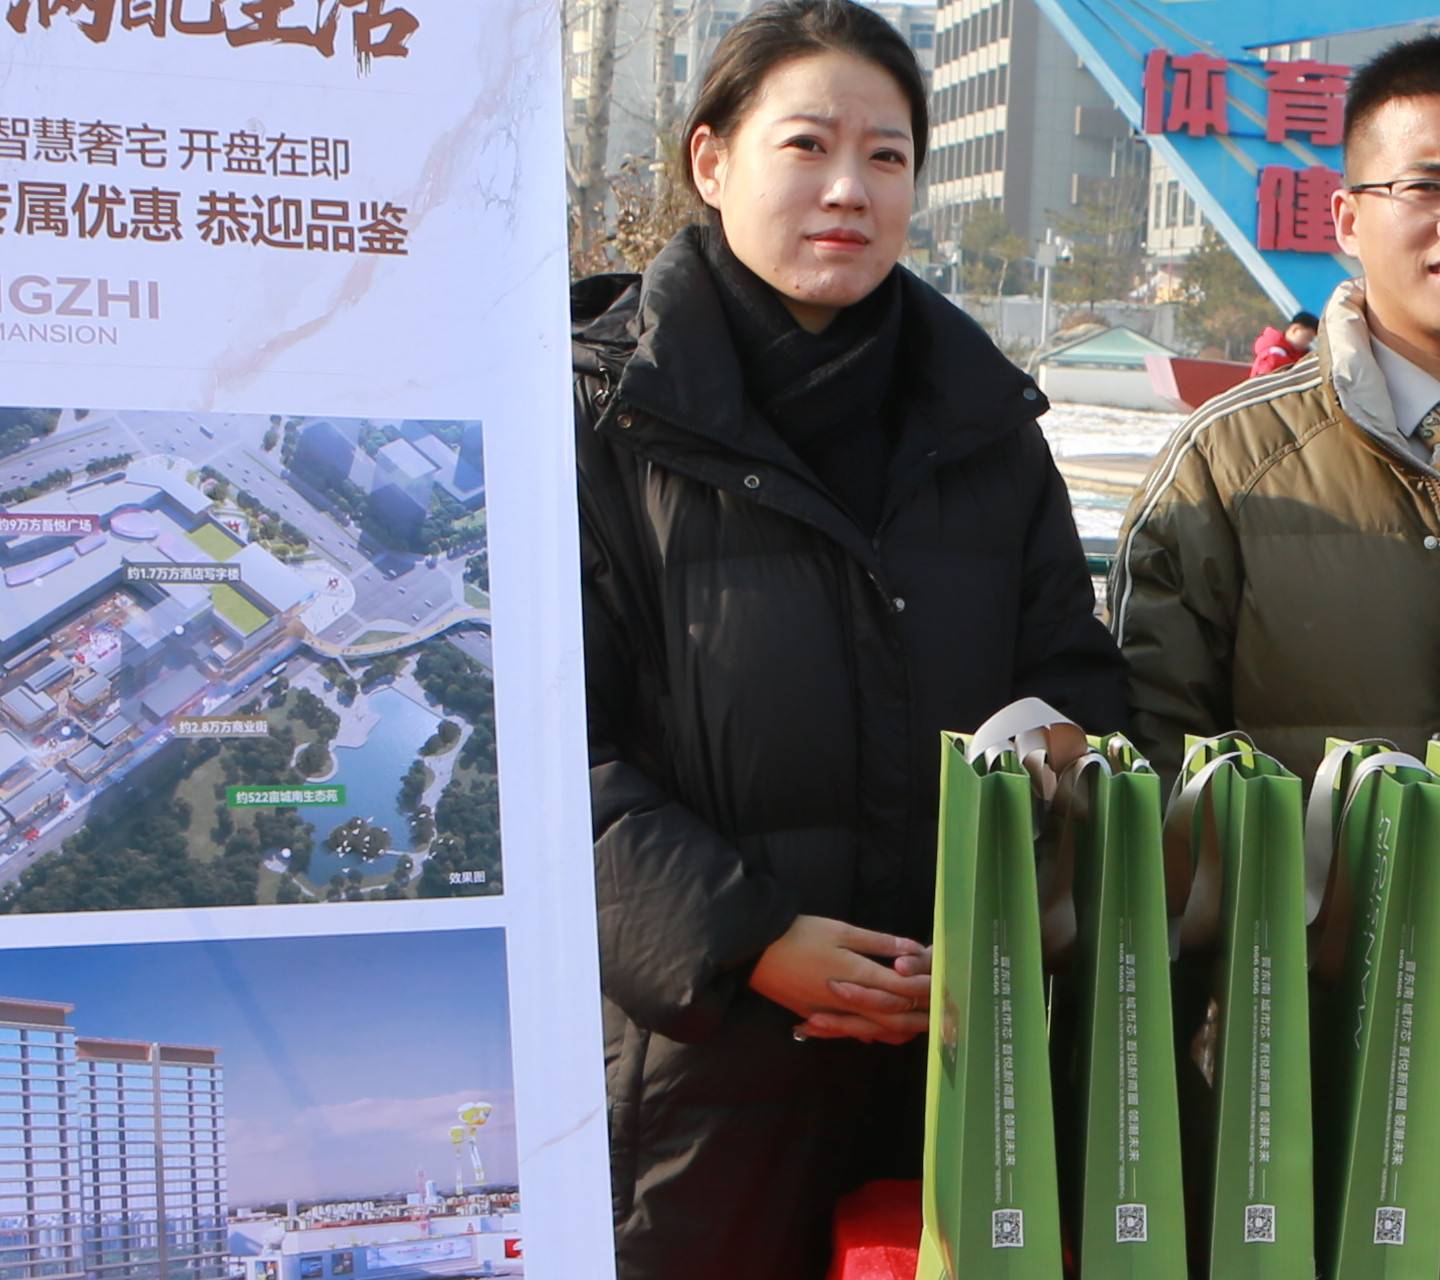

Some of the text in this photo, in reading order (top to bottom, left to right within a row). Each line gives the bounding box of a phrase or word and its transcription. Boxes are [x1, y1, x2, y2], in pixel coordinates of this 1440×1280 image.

[178, 127, 351, 181] 开盘在即
[196, 188, 410, 256] 恭迎品鉴
[235, 788, 339, 806] 约522亩城南生态苑
[448, 870, 487, 886] 效果图
